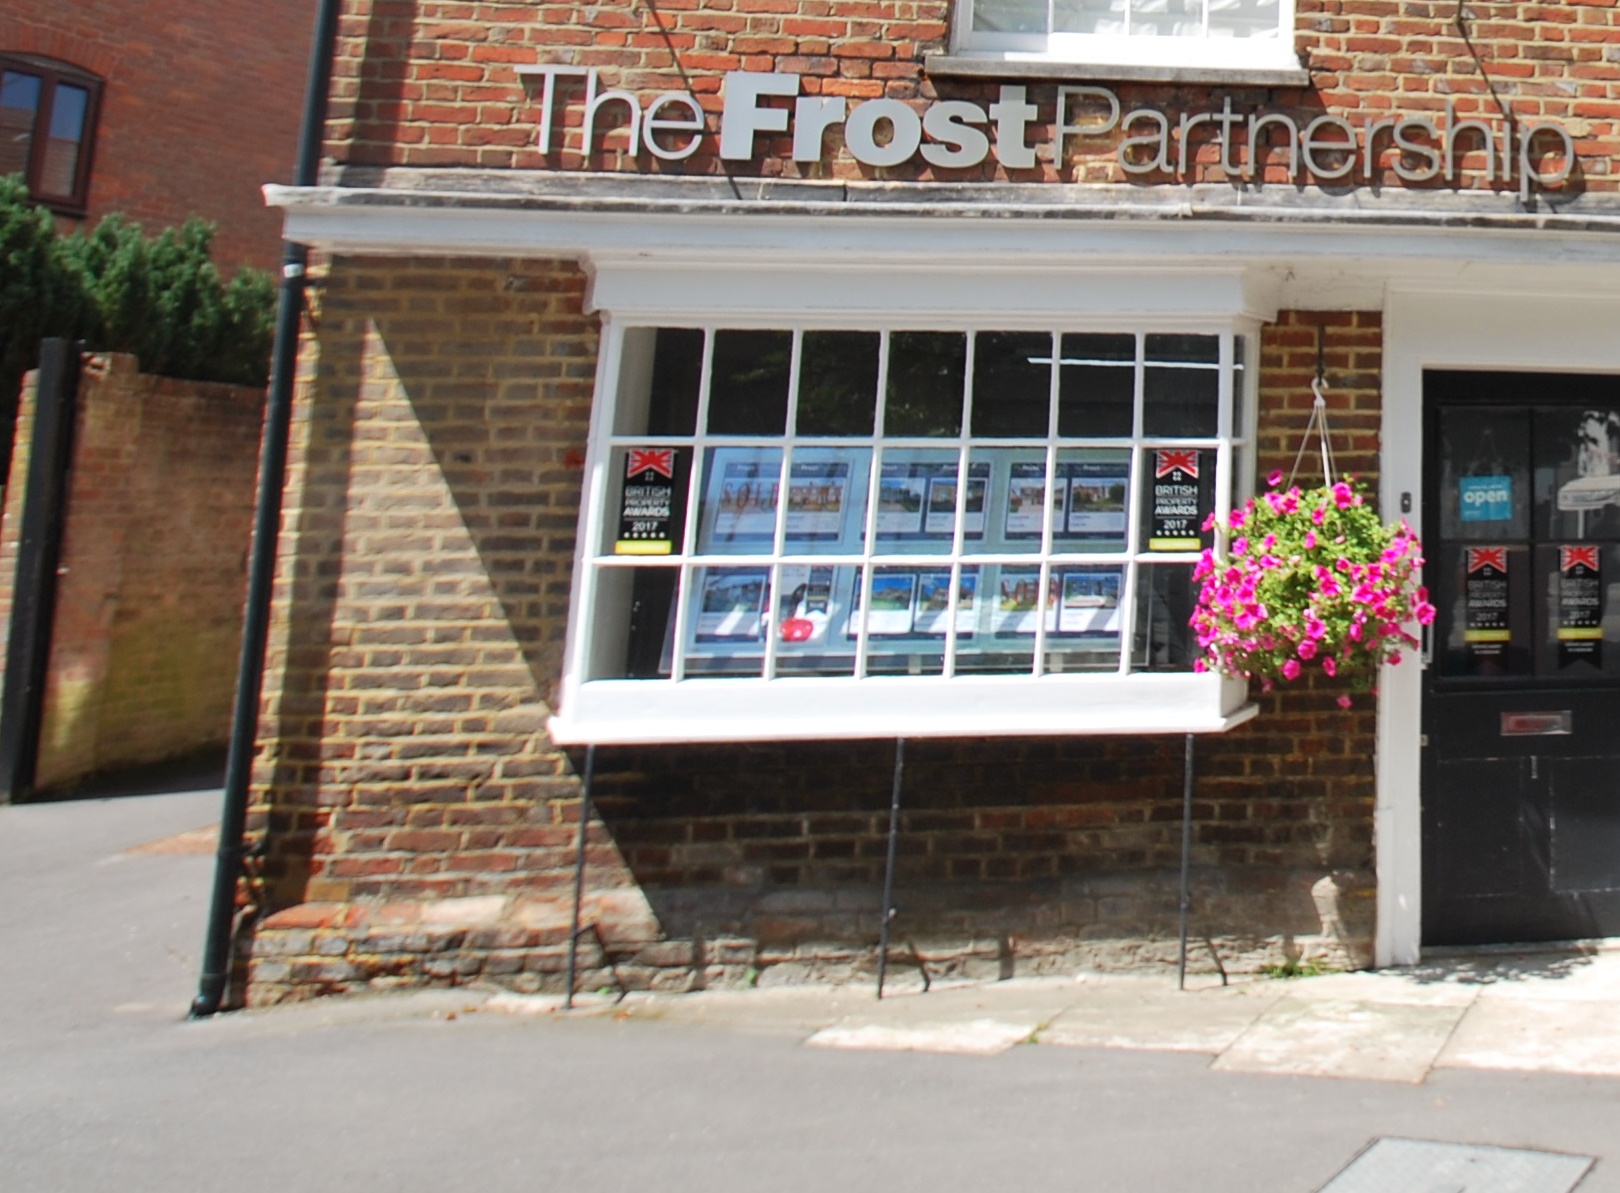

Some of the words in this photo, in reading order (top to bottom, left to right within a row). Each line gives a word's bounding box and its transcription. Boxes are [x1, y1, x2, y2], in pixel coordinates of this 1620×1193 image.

[512, 64, 705, 161] The
[719, 71, 1038, 169] Frost
[1053, 84, 1574, 202] Partnership
[625, 485, 671, 497] BRITISH
[1155, 485, 1198, 496] BRITISH
[1463, 490, 1508, 507] open
[623, 506, 670, 517] AWARDS
[1154, 505, 1198, 515] AWARDS
[632, 521, 658, 531] 2017
[1163, 519, 1187, 529] 2017
